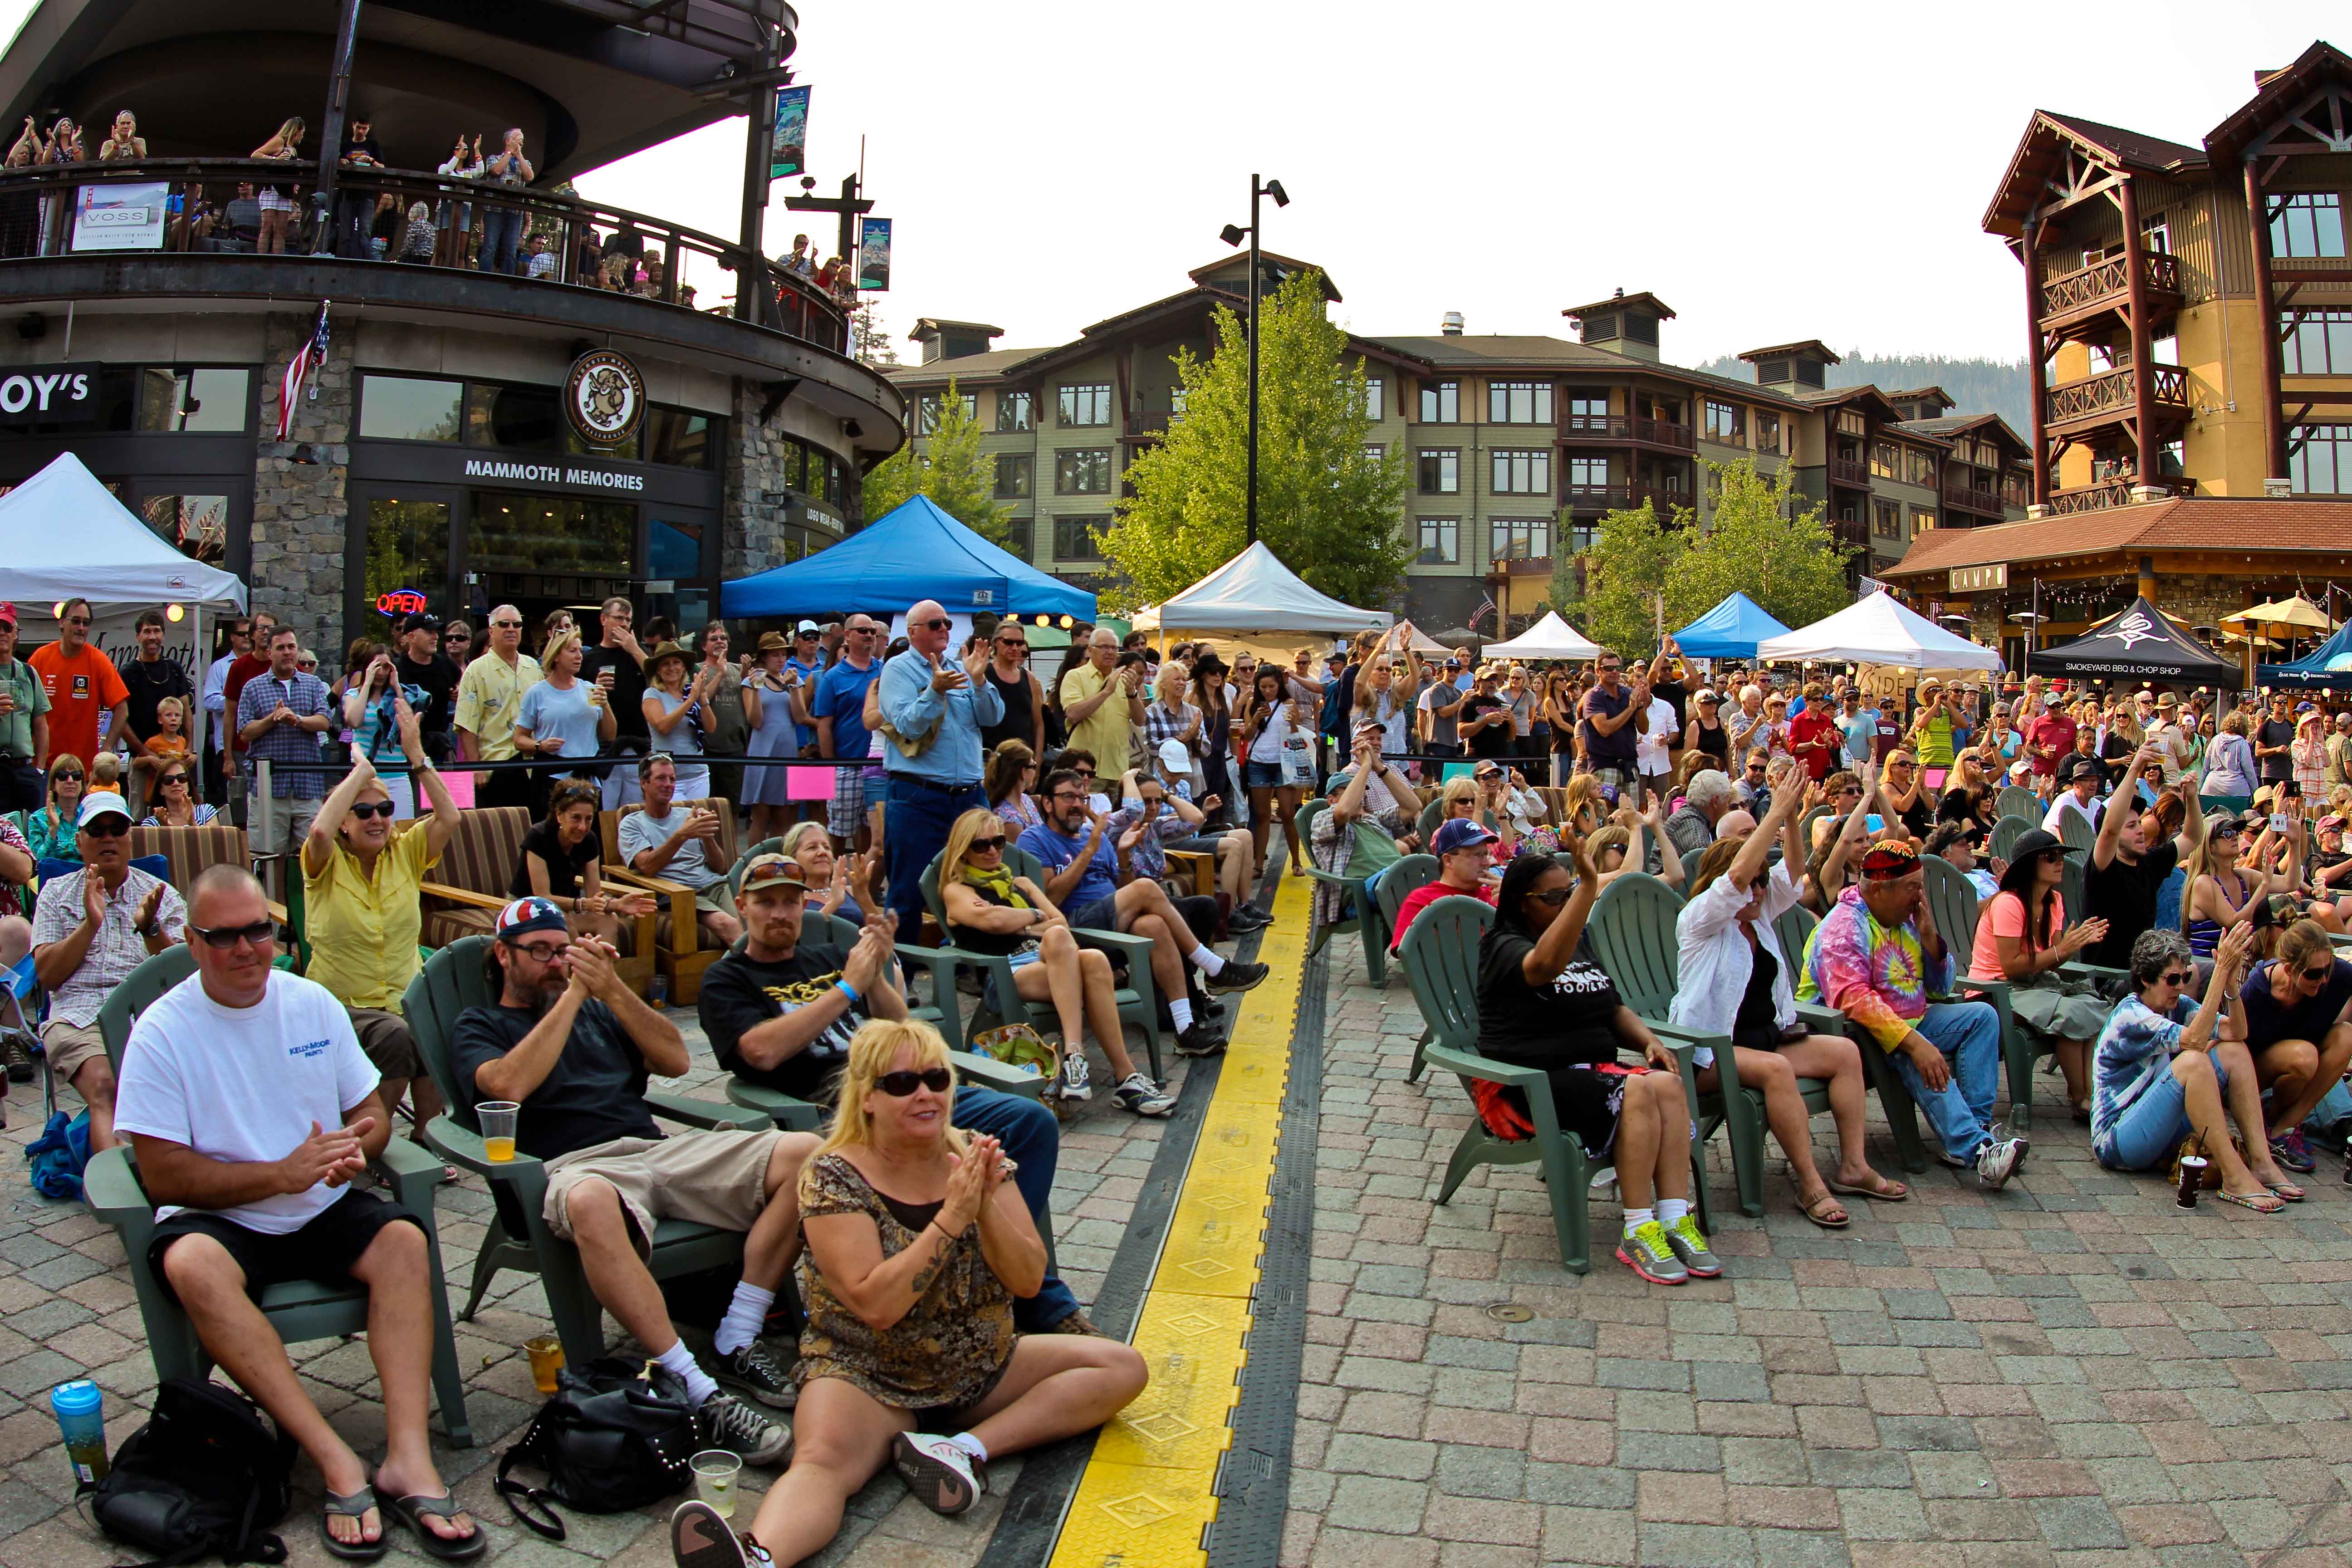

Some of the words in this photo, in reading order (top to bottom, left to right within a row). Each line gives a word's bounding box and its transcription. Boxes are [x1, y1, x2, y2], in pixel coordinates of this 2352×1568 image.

[88, 212, 142, 221] VOSS
[573, 357, 606, 386] MAMMOTH
[611, 358, 640, 396] MOUNTAIN
[0, 374, 88, 413] OY'S
[582, 423, 625, 439] CALIFORNIA
[465, 460, 559, 482] MAMMOTH
[566, 469, 643, 490] MEMORIES
[807, 508, 819, 522] LOGO
[820, 512, 830, 526] WEAR
[1952, 567, 2003, 589] CAMPO
[377, 594, 426, 613] OPEN
[2066, 663, 2110, 671] SMOKEYARD
[2136, 666, 2158, 674] CHOP
[2160, 667, 2181, 675] SHOP
[1867, 671, 1905, 697] SIDE
[1634, 1249, 1646, 1263] FILA
